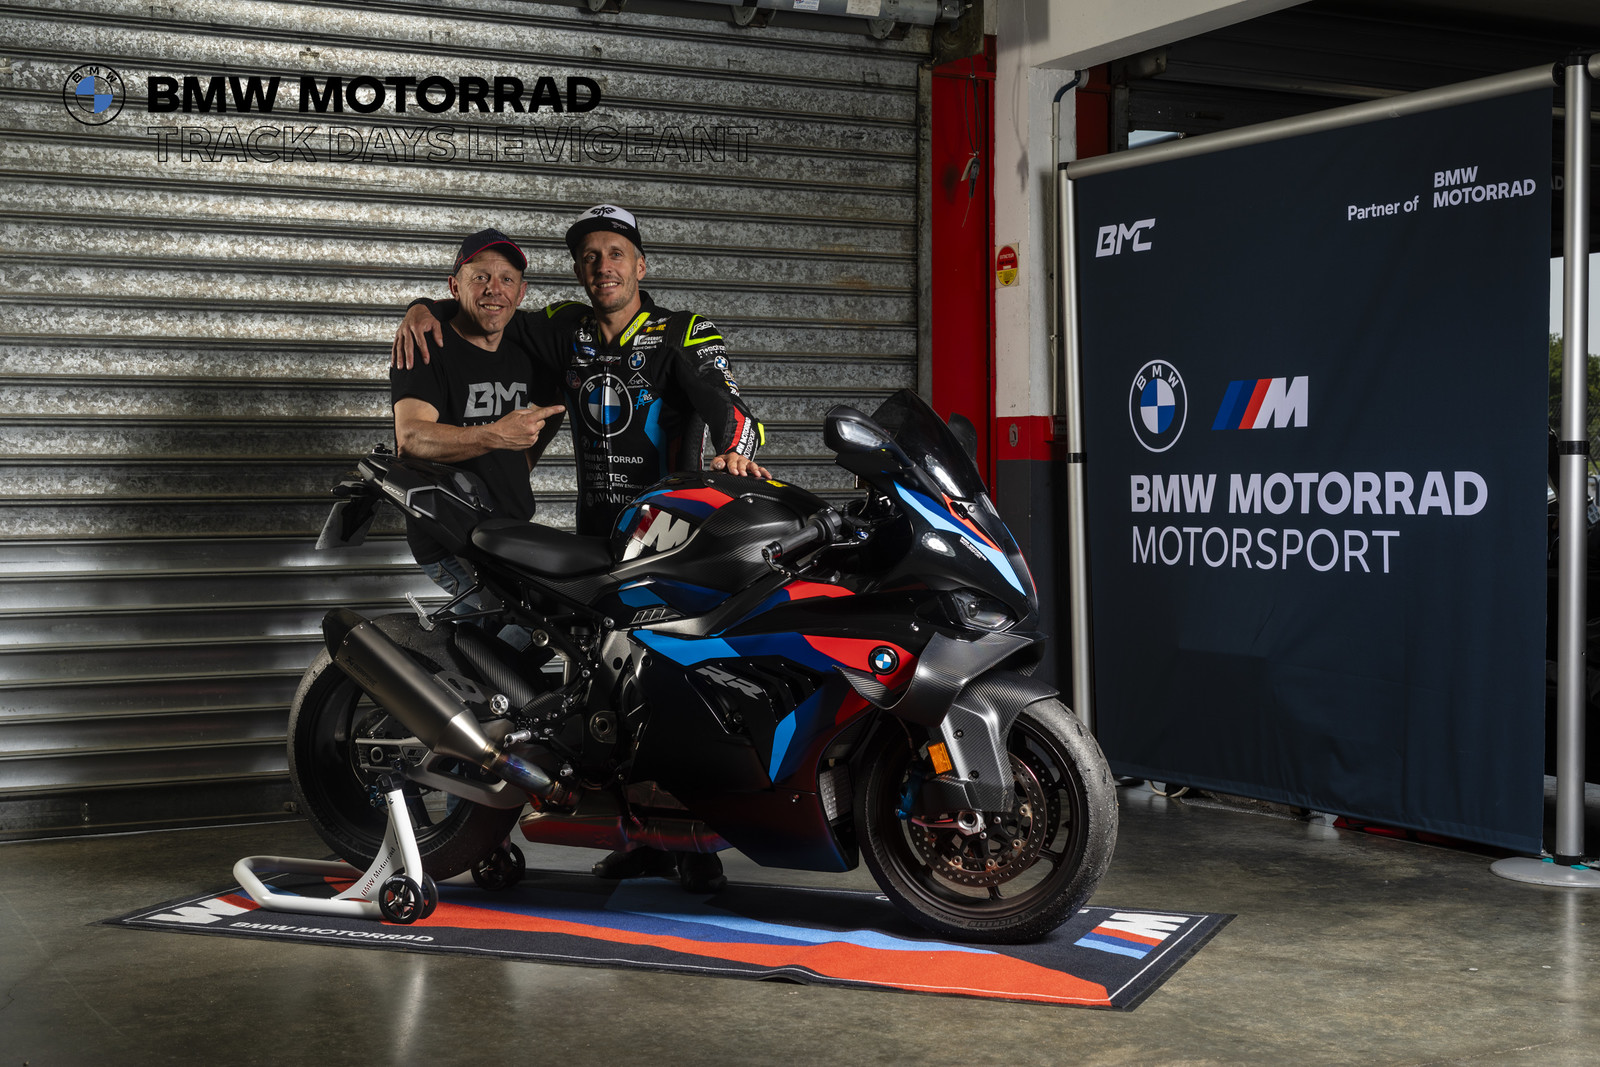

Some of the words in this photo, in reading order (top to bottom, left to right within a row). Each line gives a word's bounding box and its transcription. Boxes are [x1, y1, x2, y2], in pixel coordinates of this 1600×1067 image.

[1433, 166, 1479, 188] BMW
[1433, 178, 1537, 208] MOTORRAD
[1347, 202, 1400, 221] Partner
[1403, 195, 1419, 213] of
[1095, 218, 1156, 258] BMC
[1136, 365, 1179, 391] BMW
[464, 381, 527, 418] BMC
[1252, 376, 1309, 429] M
[1130, 473, 1217, 513] BMW
[1228, 471, 1489, 516] MOTORRAD
[1132, 525, 1400, 574] MOTORSPORT
[695, 665, 764, 700] RR
[229, 921, 297, 932] BMW
[297, 925, 435, 943] MOTORRAD
